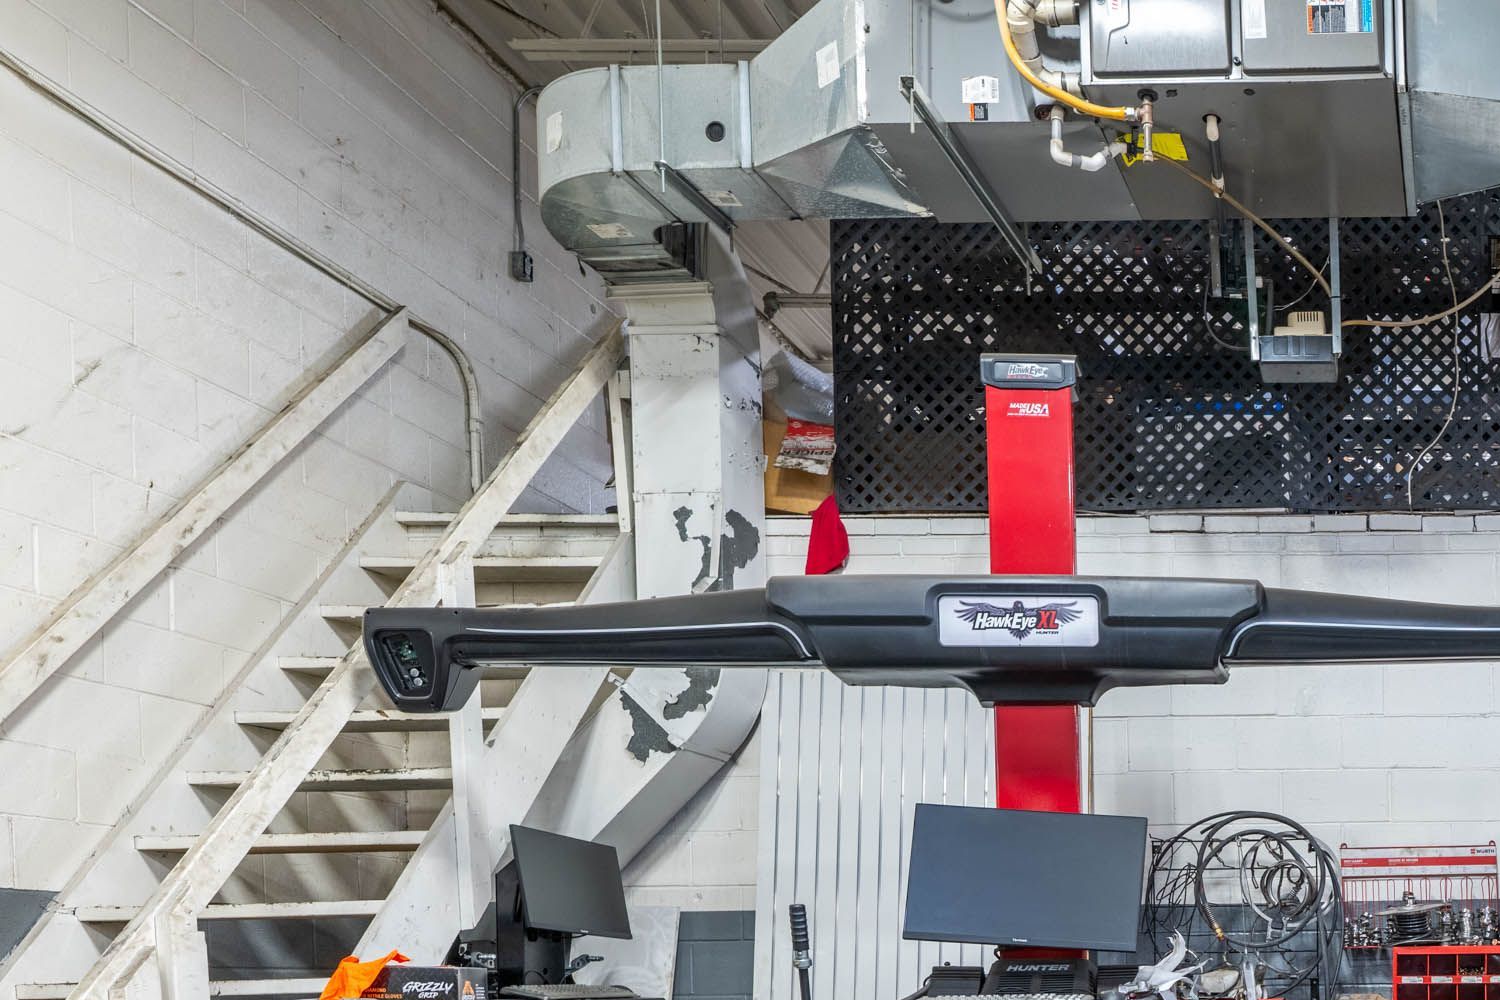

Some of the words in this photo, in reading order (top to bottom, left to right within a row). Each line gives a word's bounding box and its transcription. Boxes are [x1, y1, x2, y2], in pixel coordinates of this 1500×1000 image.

[1027, 403, 1049, 414] USA
[973, 611, 1037, 631] HawkEye
[1036, 609, 1059, 630] XL
[1006, 964, 1071, 972] HUNTER
[402, 981, 454, 995] GRIZZLY
